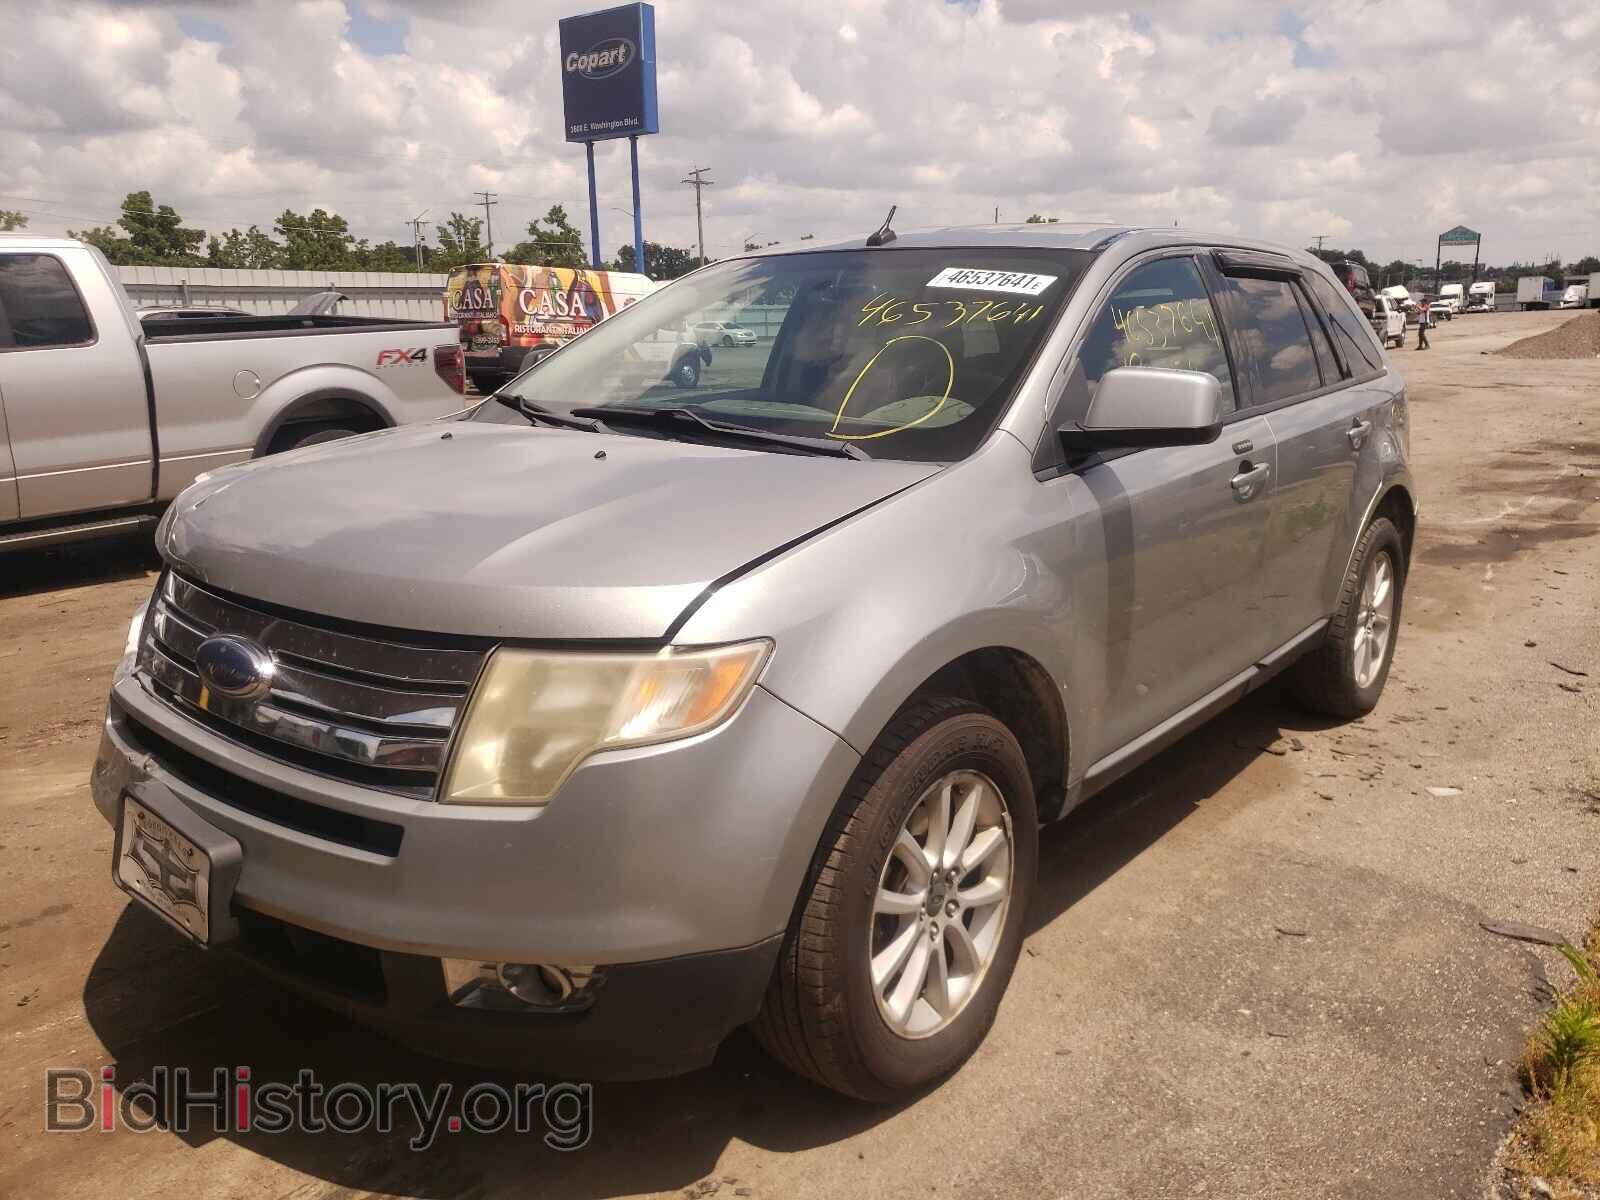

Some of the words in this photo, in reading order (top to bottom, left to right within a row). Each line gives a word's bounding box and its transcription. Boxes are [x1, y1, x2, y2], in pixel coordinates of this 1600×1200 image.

[566, 42, 626, 73] Copart
[947, 269, 1038, 289] 46537641
[453, 288, 495, 310] CASA
[519, 289, 588, 317] CASA
[858, 291, 1045, 328] 46537641
[564, 326, 591, 336] ITALIAN
[376, 348, 427, 365] FX4
